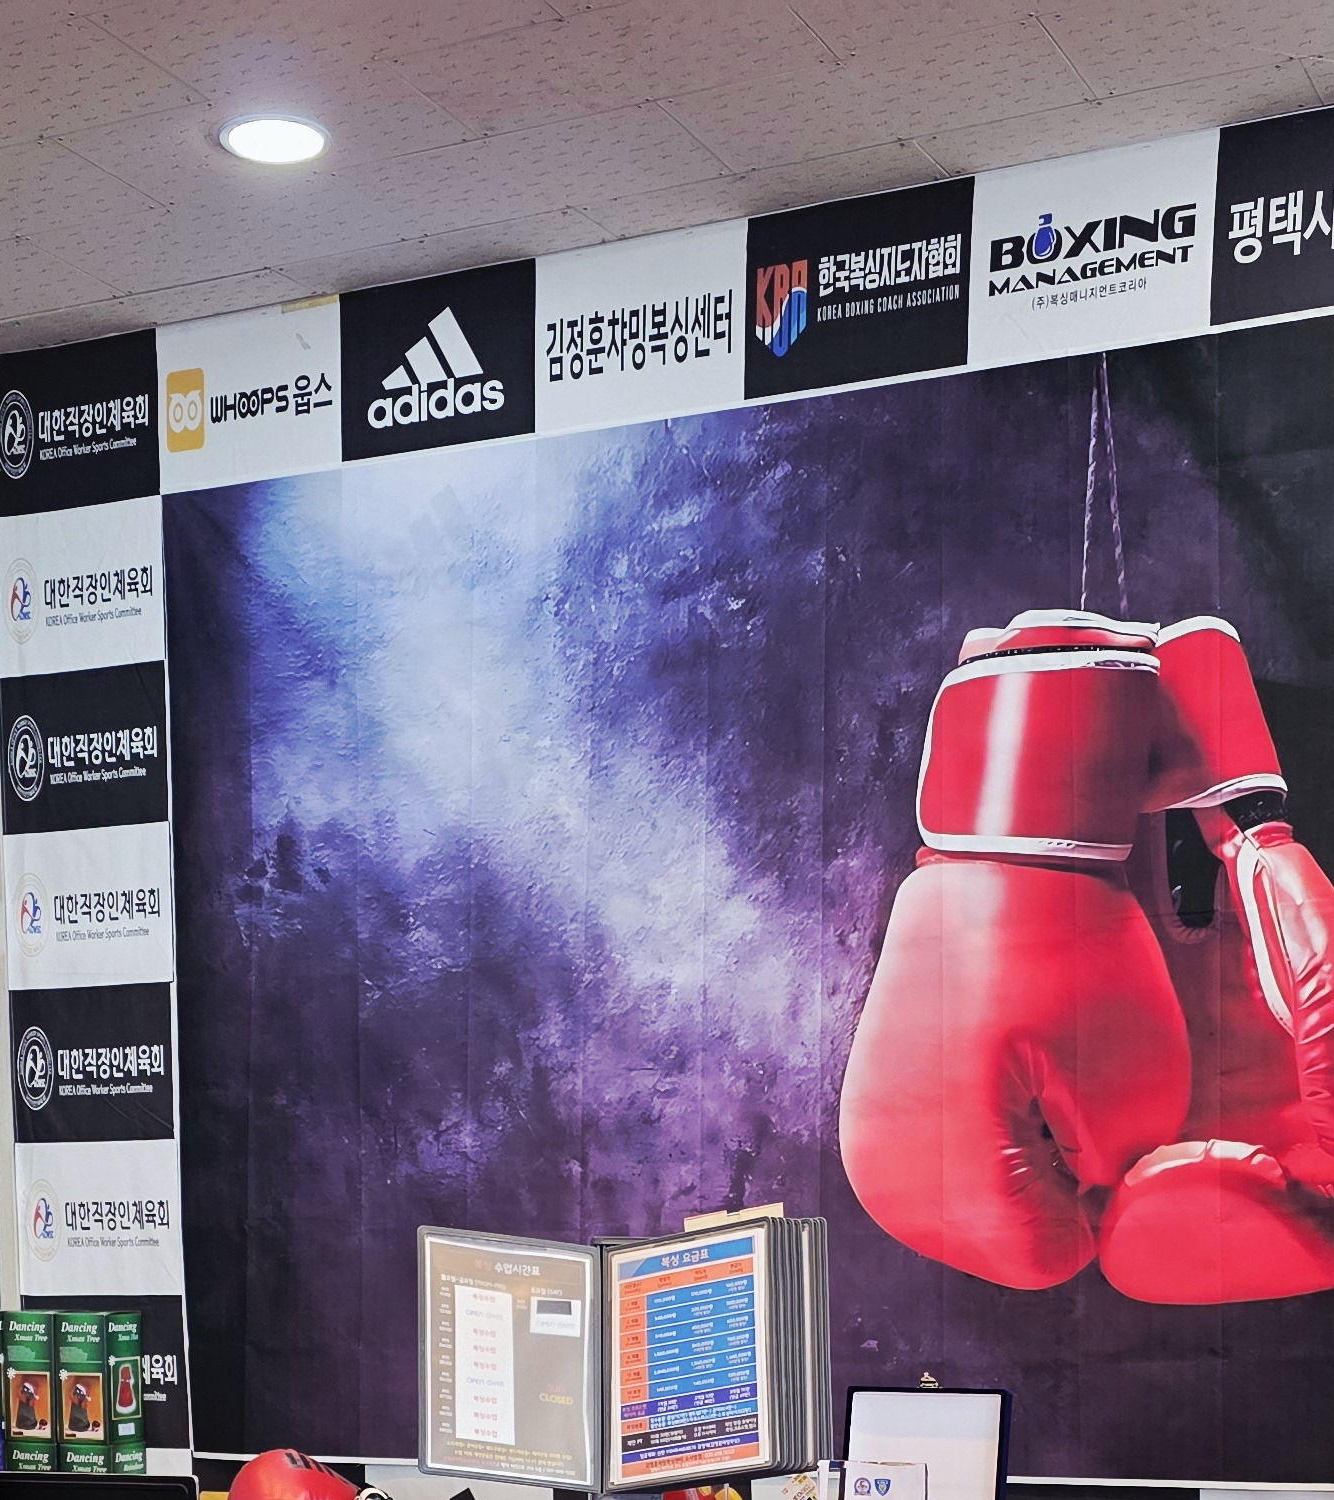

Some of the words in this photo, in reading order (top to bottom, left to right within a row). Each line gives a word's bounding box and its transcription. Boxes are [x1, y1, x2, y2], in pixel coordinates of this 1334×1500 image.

[989, 203, 1197, 273] BOXING
[818, 233, 962, 298] 한국복싱지도자협회
[988, 244, 1194, 297] MANAGEMENT
[817, 304, 842, 323] KOREA
[845, 298, 874, 317] BOXING
[877, 294, 903, 312] COACH
[906, 284, 960, 309] ASSOCIATION
[545, 288, 734, 382] 김정훈챠밍복싱센터
[293, 372, 333, 416] 웁스
[367, 376, 505, 430] adidas
[38, 393, 149, 443] 대한직장인체육회
[91, 440, 109, 455] Sports
[44, 565, 153, 609] 대한직장인체육회
[45, 615, 63, 627] KOREA
[79, 611, 97, 623] Worker
[97, 609, 114, 623] Sports
[115, 606, 142, 619] Committee
[47, 725, 158, 768] 대한직장인체육회
[101, 768, 118, 782] Sports
[54, 887, 161, 925] 대한직장인체육회
[87, 929, 105, 940] Worker
[105, 928, 122, 941] Sports
[123, 926, 150, 938] Committee
[57, 1044, 165, 1080] 대한직장인체육회
[109, 1083, 126, 1096] Sports
[65, 1199, 170, 1231] 대한직장인체육회
[67, 1237, 85, 1247] KOREA
[117, 1236, 134, 1248] Sports
[135, 1236, 159, 1246] Committee
[682, 1248, 709, 1264] 요금표
[494, 1262, 541, 1277] 수업시간표
[9, 1320, 46, 1334] Dancing
[61, 1322, 97, 1334] Dancing
[108, 1321, 137, 1333] Dancing
[539, 1392, 573, 1406] CLOSED
[13, 1450, 50, 1463] Dancing
[67, 1451, 105, 1465] Dancing
[115, 1451, 143, 1464] Dancing
